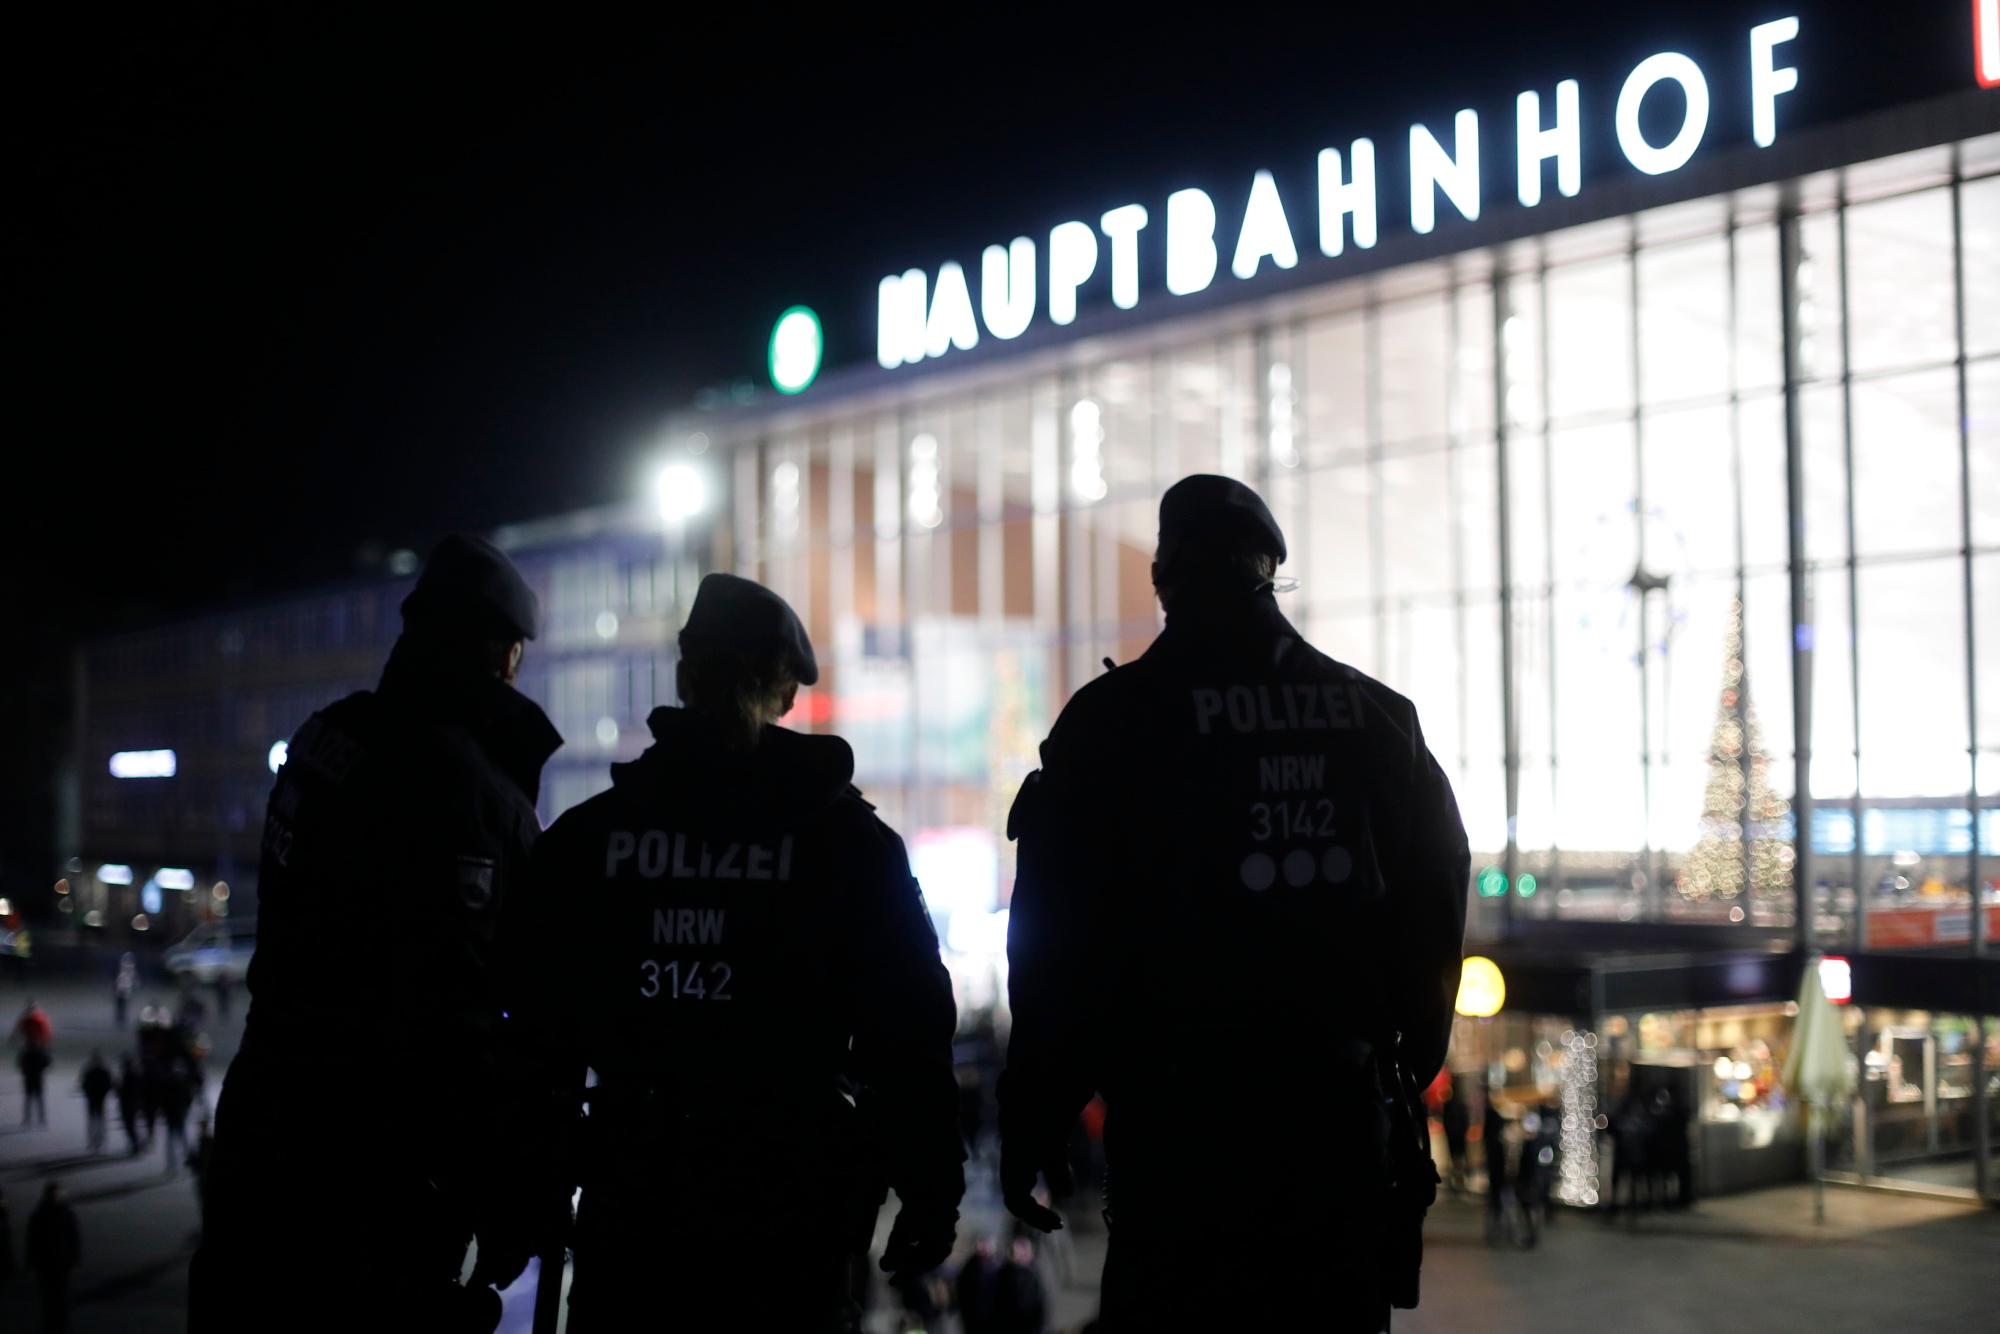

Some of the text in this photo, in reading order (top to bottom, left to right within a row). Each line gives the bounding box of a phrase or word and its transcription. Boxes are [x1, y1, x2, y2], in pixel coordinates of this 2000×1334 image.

[877, 15, 1800, 369] HAUPTBAHNHOF
[1192, 683, 1366, 734] POLIZEI
[1258, 753, 1326, 792] NRW
[1249, 798, 1337, 841] 3142
[605, 829, 794, 882] POLIZEI
[653, 907, 727, 945] NRW
[640, 959, 733, 1001] 3142
